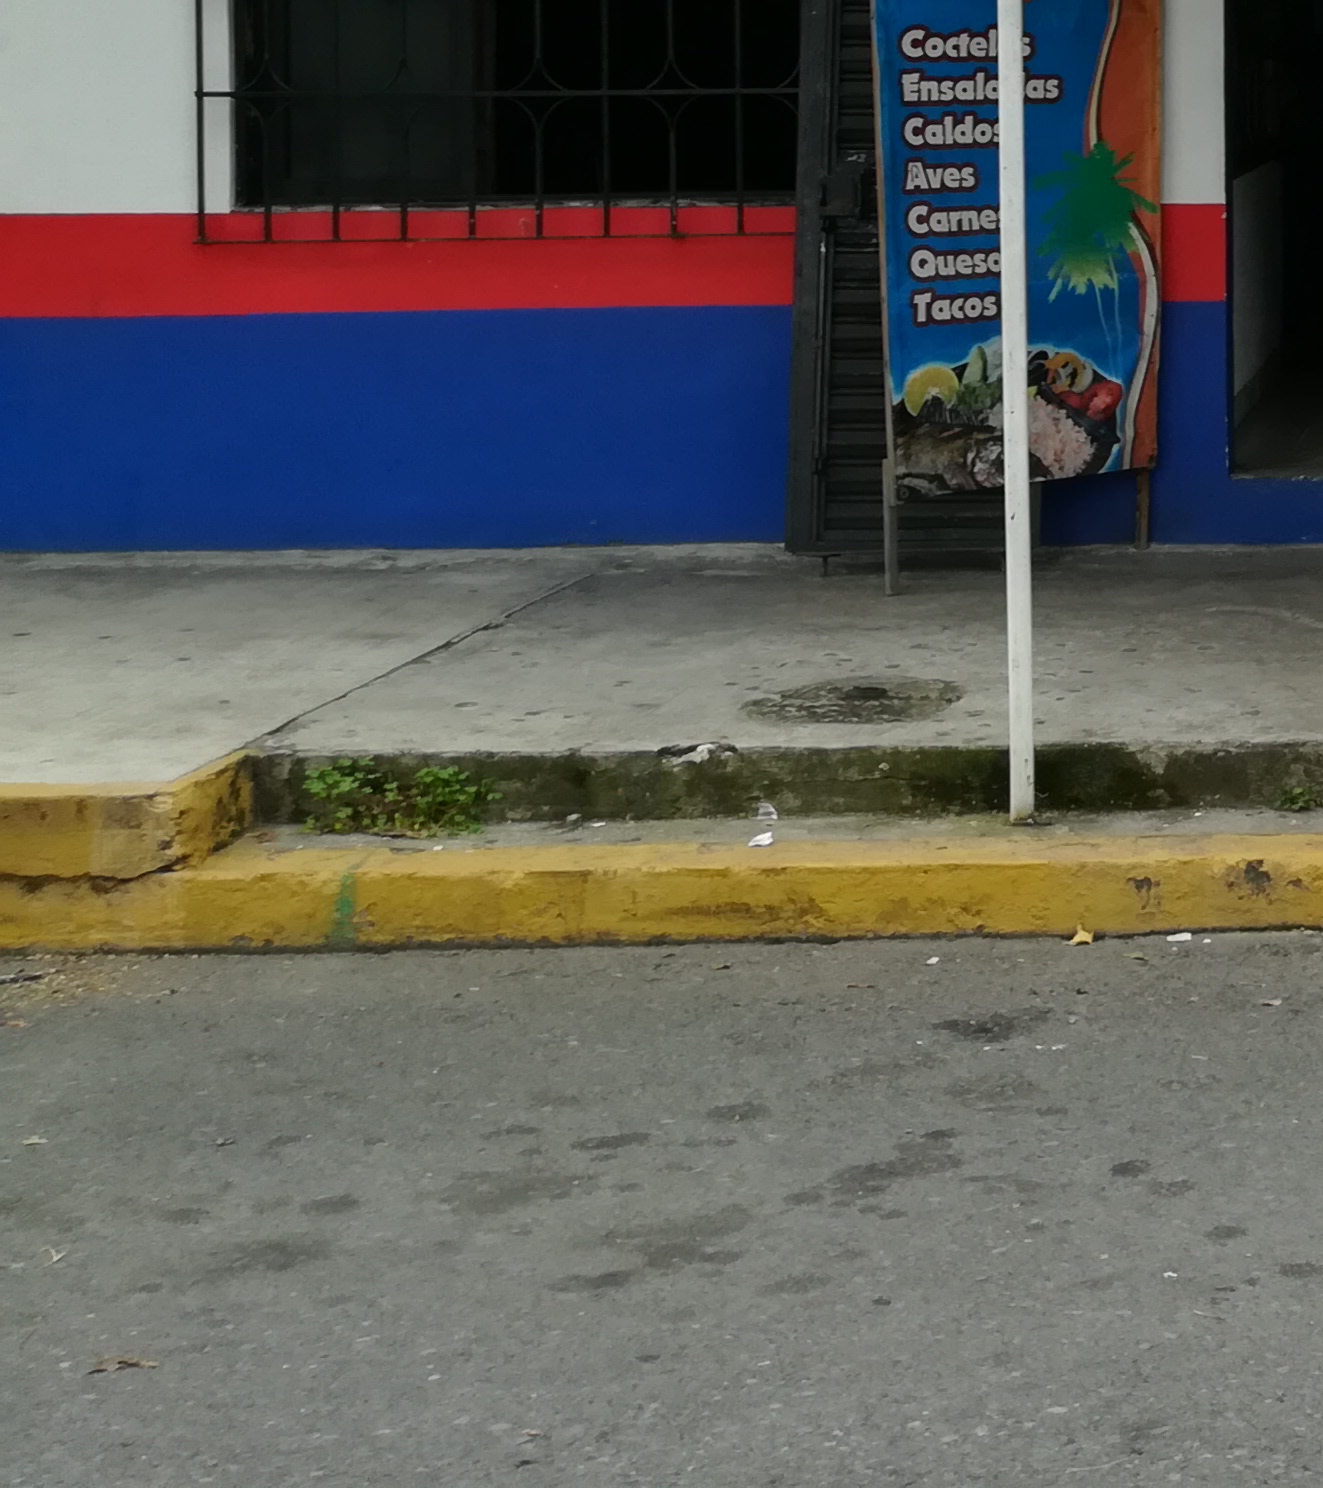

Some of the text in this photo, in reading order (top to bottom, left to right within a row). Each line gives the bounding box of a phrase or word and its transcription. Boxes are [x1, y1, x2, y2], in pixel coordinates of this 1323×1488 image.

[902, 29, 1031, 58] Coctels
[902, 72, 1059, 102] Ensalaas
[905, 162, 976, 190] Aves
[907, 205, 1001, 234] Carne
[913, 293, 998, 322] Tacos
